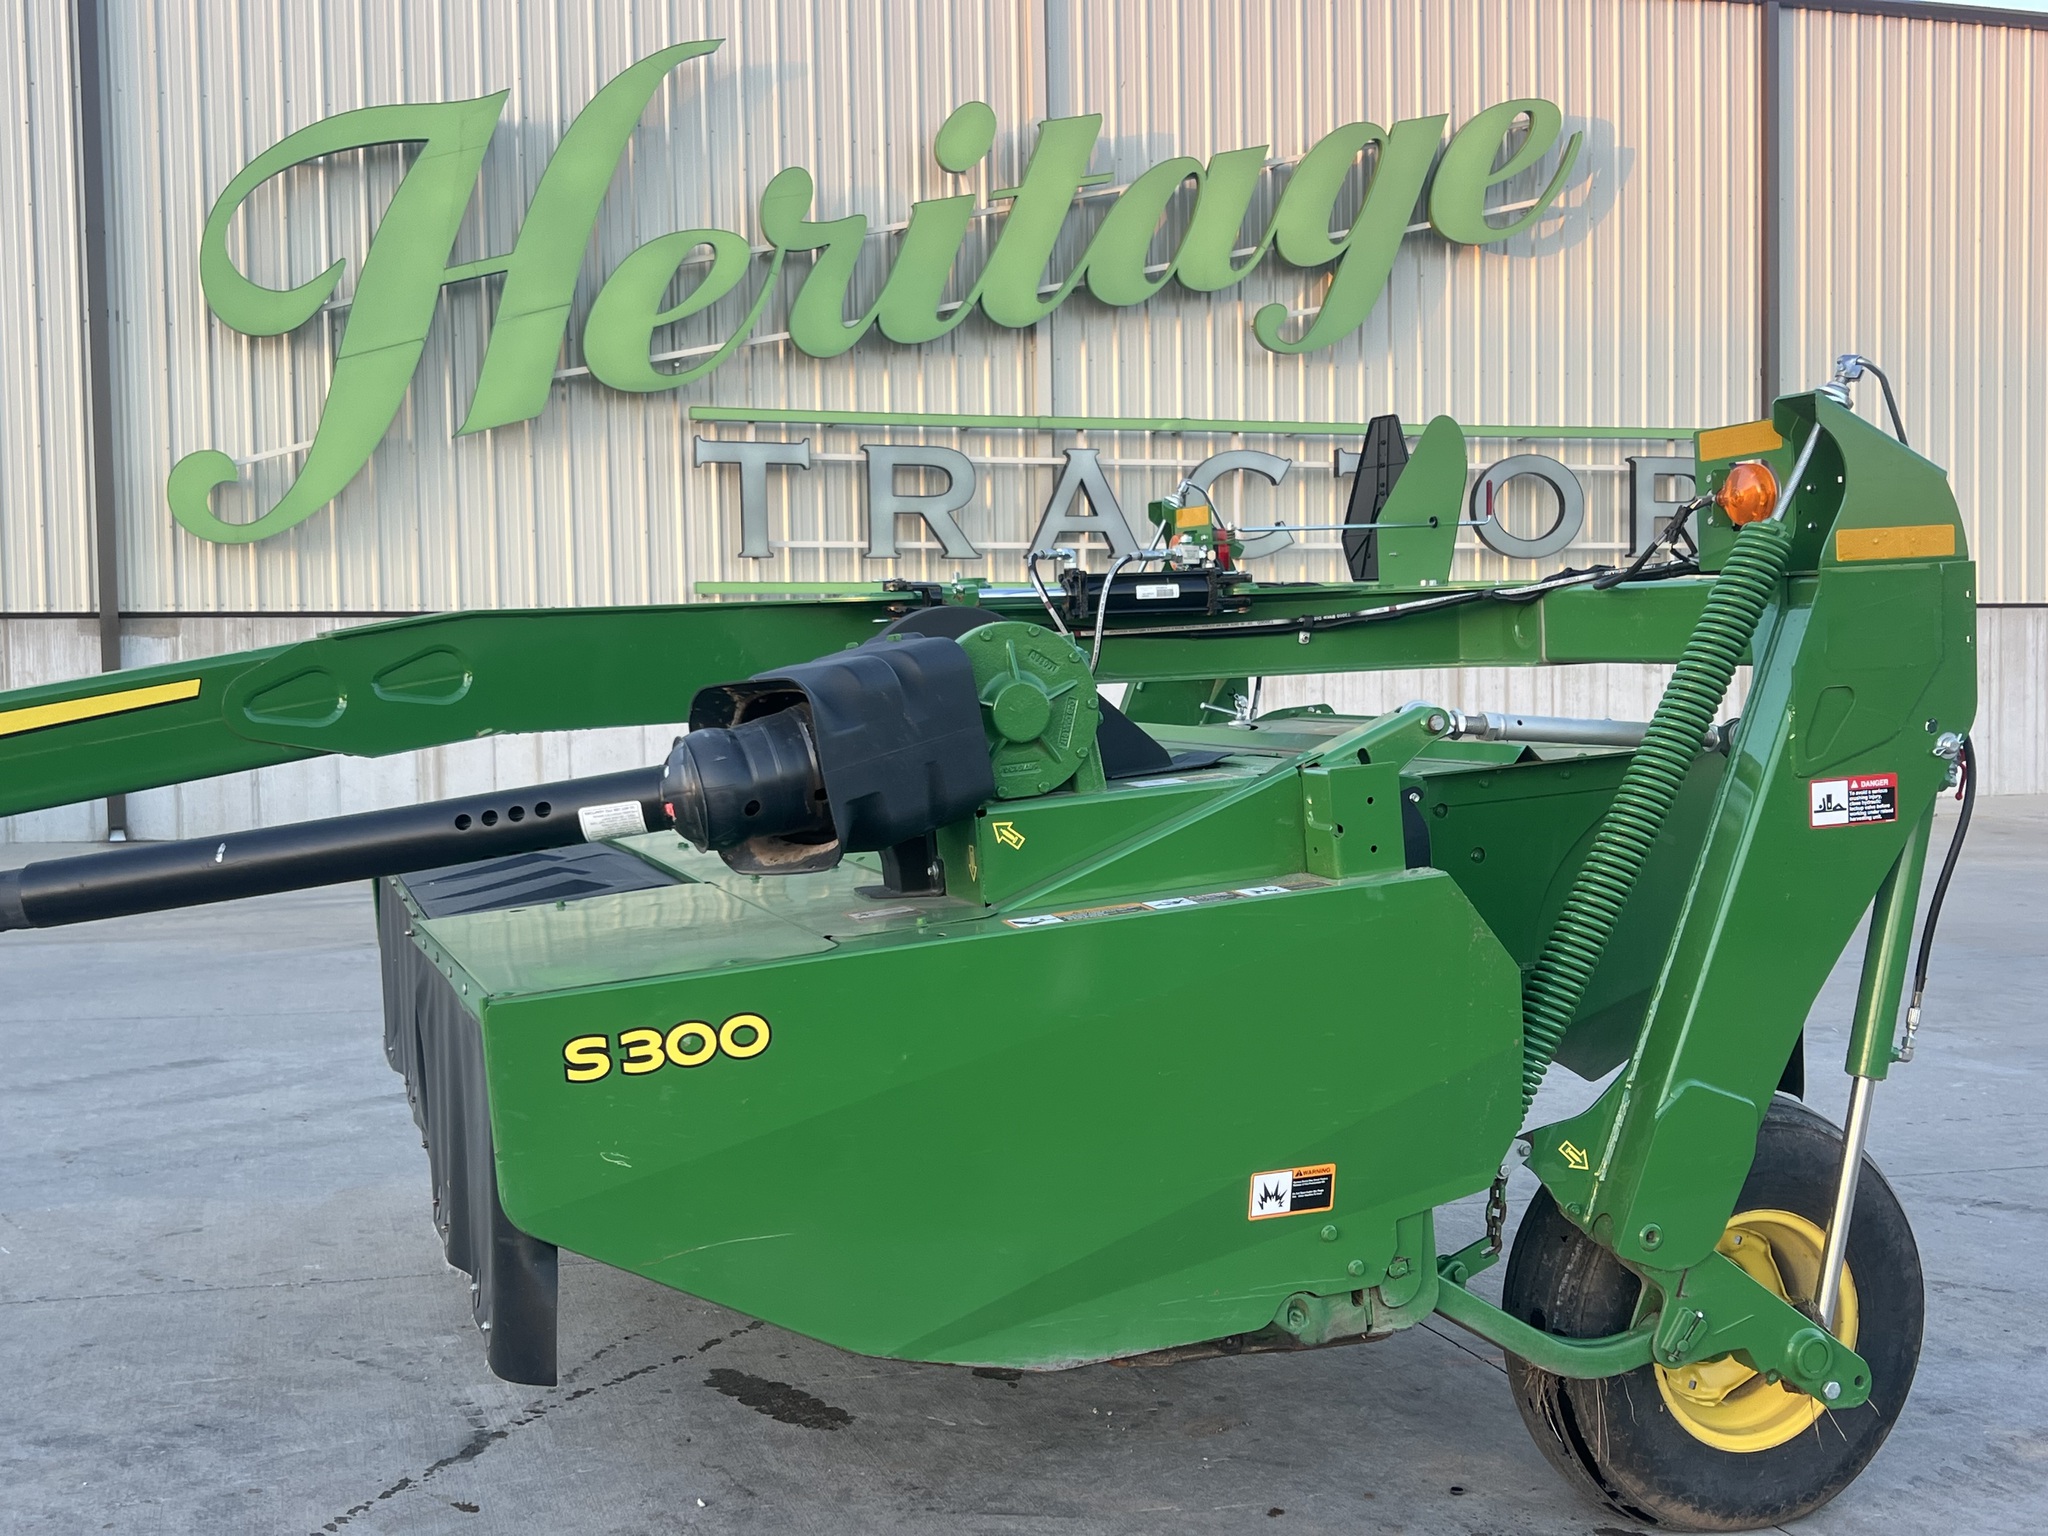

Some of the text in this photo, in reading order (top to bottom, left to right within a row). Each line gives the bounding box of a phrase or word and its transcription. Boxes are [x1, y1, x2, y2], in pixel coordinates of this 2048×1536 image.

[167, 38, 1583, 545] Heritage
[694, 434, 1698, 560] TRACOR
[1860, 779, 1889, 787] DANGER
[1303, 1167, 1331, 1175] WARNING
